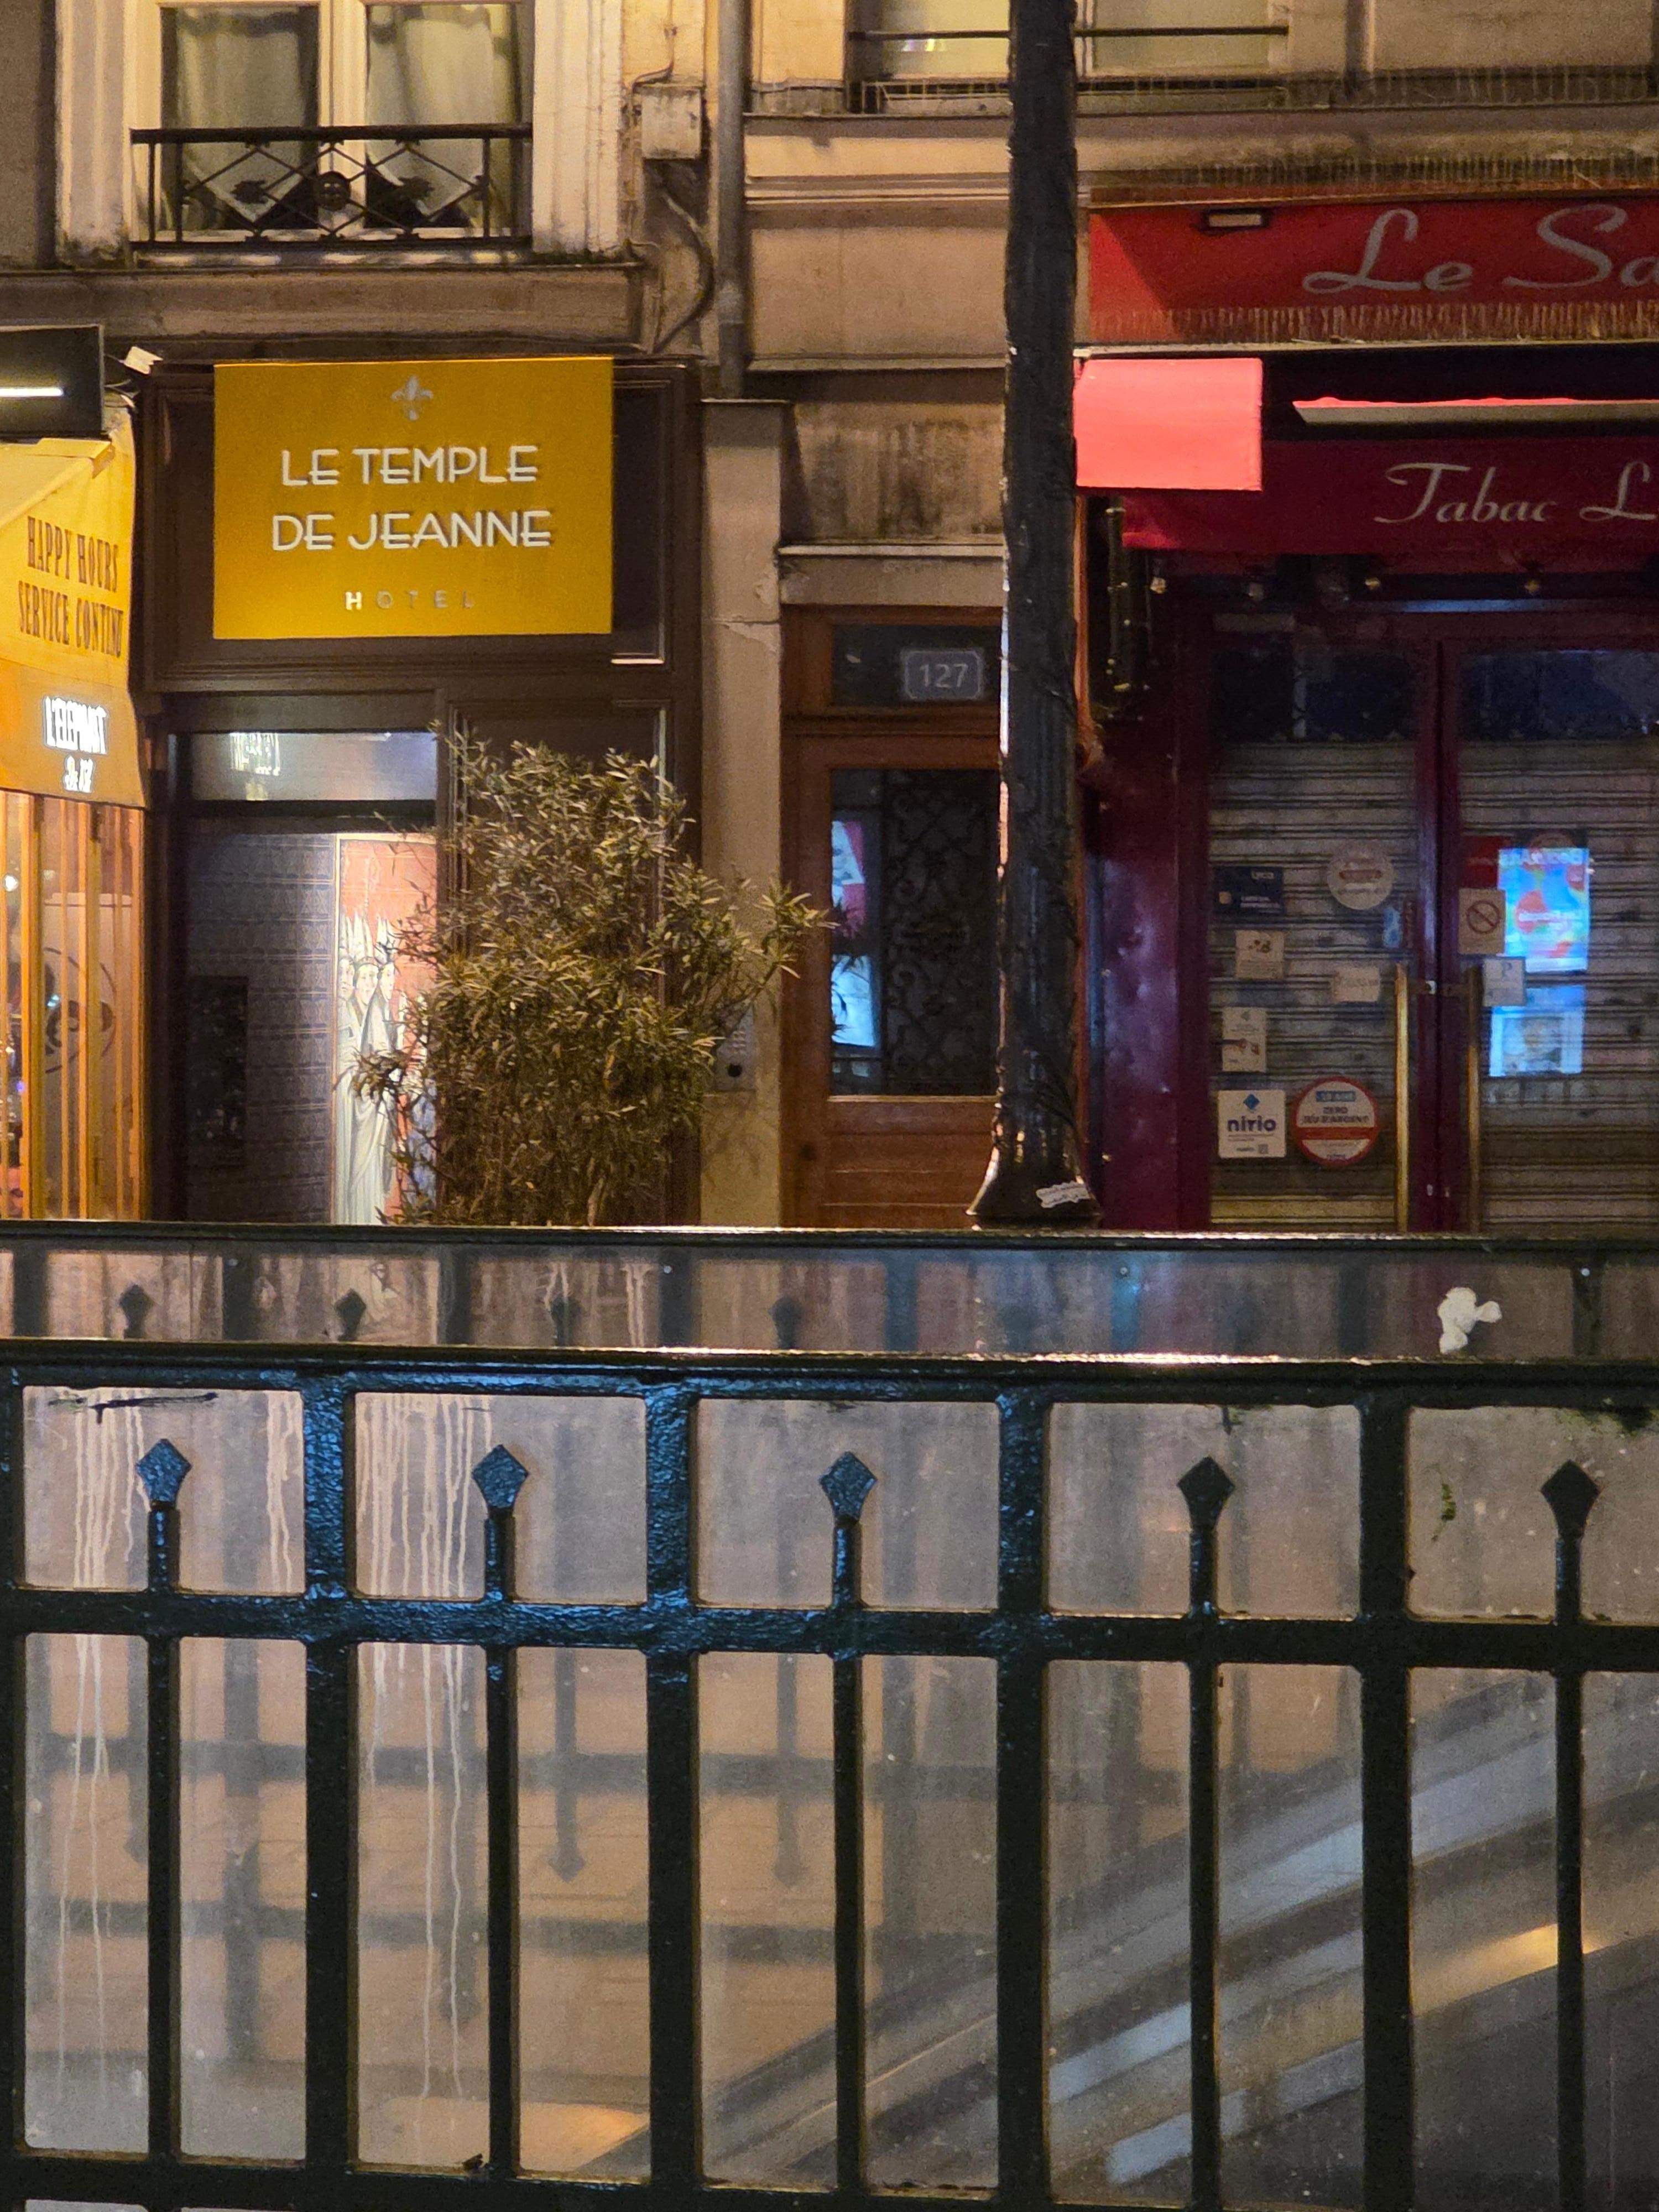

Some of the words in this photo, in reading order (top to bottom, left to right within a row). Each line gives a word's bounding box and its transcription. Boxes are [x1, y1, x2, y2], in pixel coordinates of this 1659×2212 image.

[1302, 208, 1473, 294] Le
[282, 448, 340, 487] LE
[352, 445, 539, 484] TEMPLE
[1374, 462, 1557, 524] Tabac
[273, 514, 334, 551] DE
[348, 510, 551, 550] JEANNE
[28, 515, 70, 580] HAPPY
[77, 534, 118, 593] HOURS
[18, 581, 69, 645] SERVICE
[345, 591, 474, 610] HOTEL
[920, 663, 968, 688] 127
[1227, 1115, 1277, 1132] nirio
